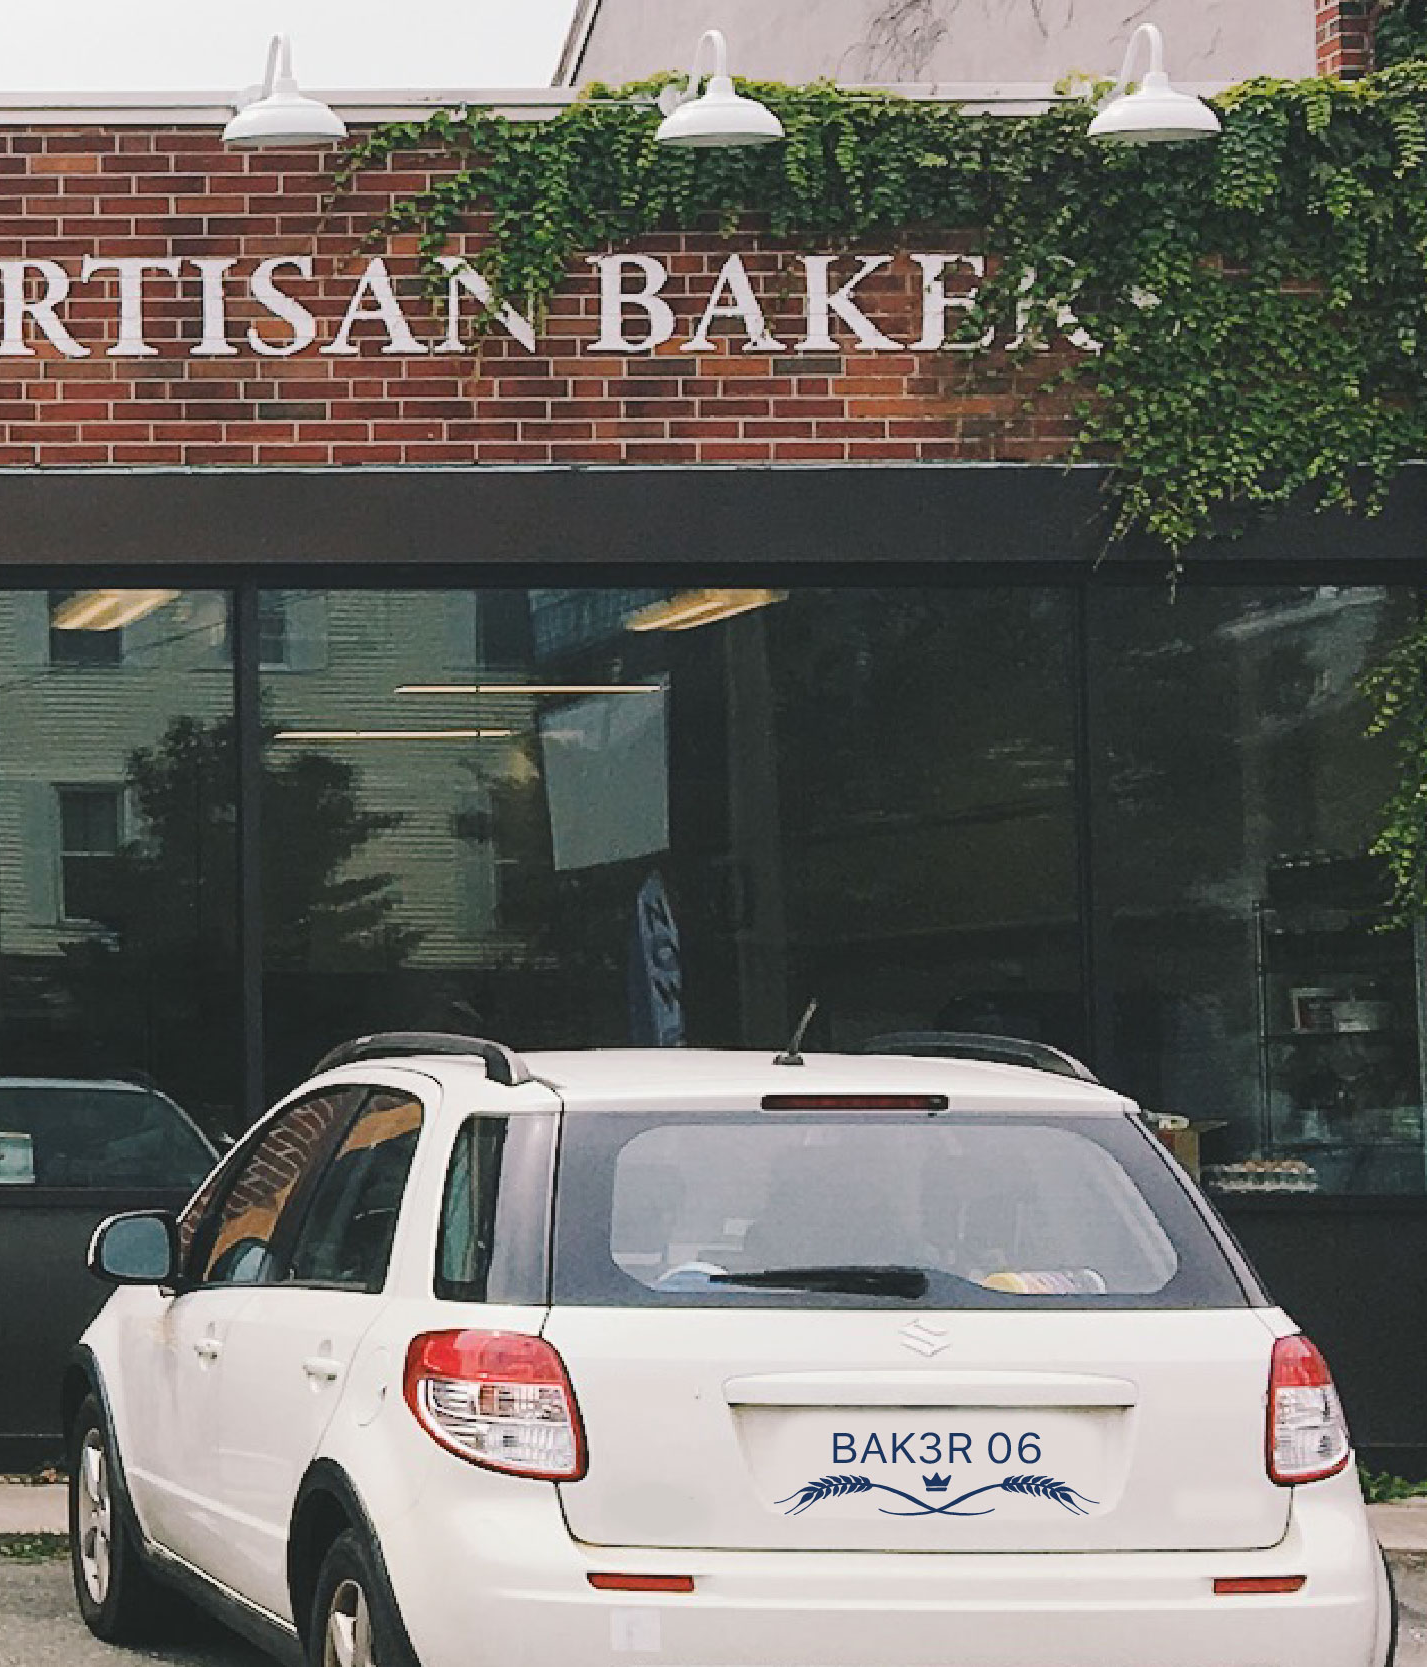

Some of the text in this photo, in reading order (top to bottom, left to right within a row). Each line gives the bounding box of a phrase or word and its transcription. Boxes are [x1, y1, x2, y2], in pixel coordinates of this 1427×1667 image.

[585, 253, 1161, 356] BAKER
[831, 1432, 1043, 1465] BAK3R 06
